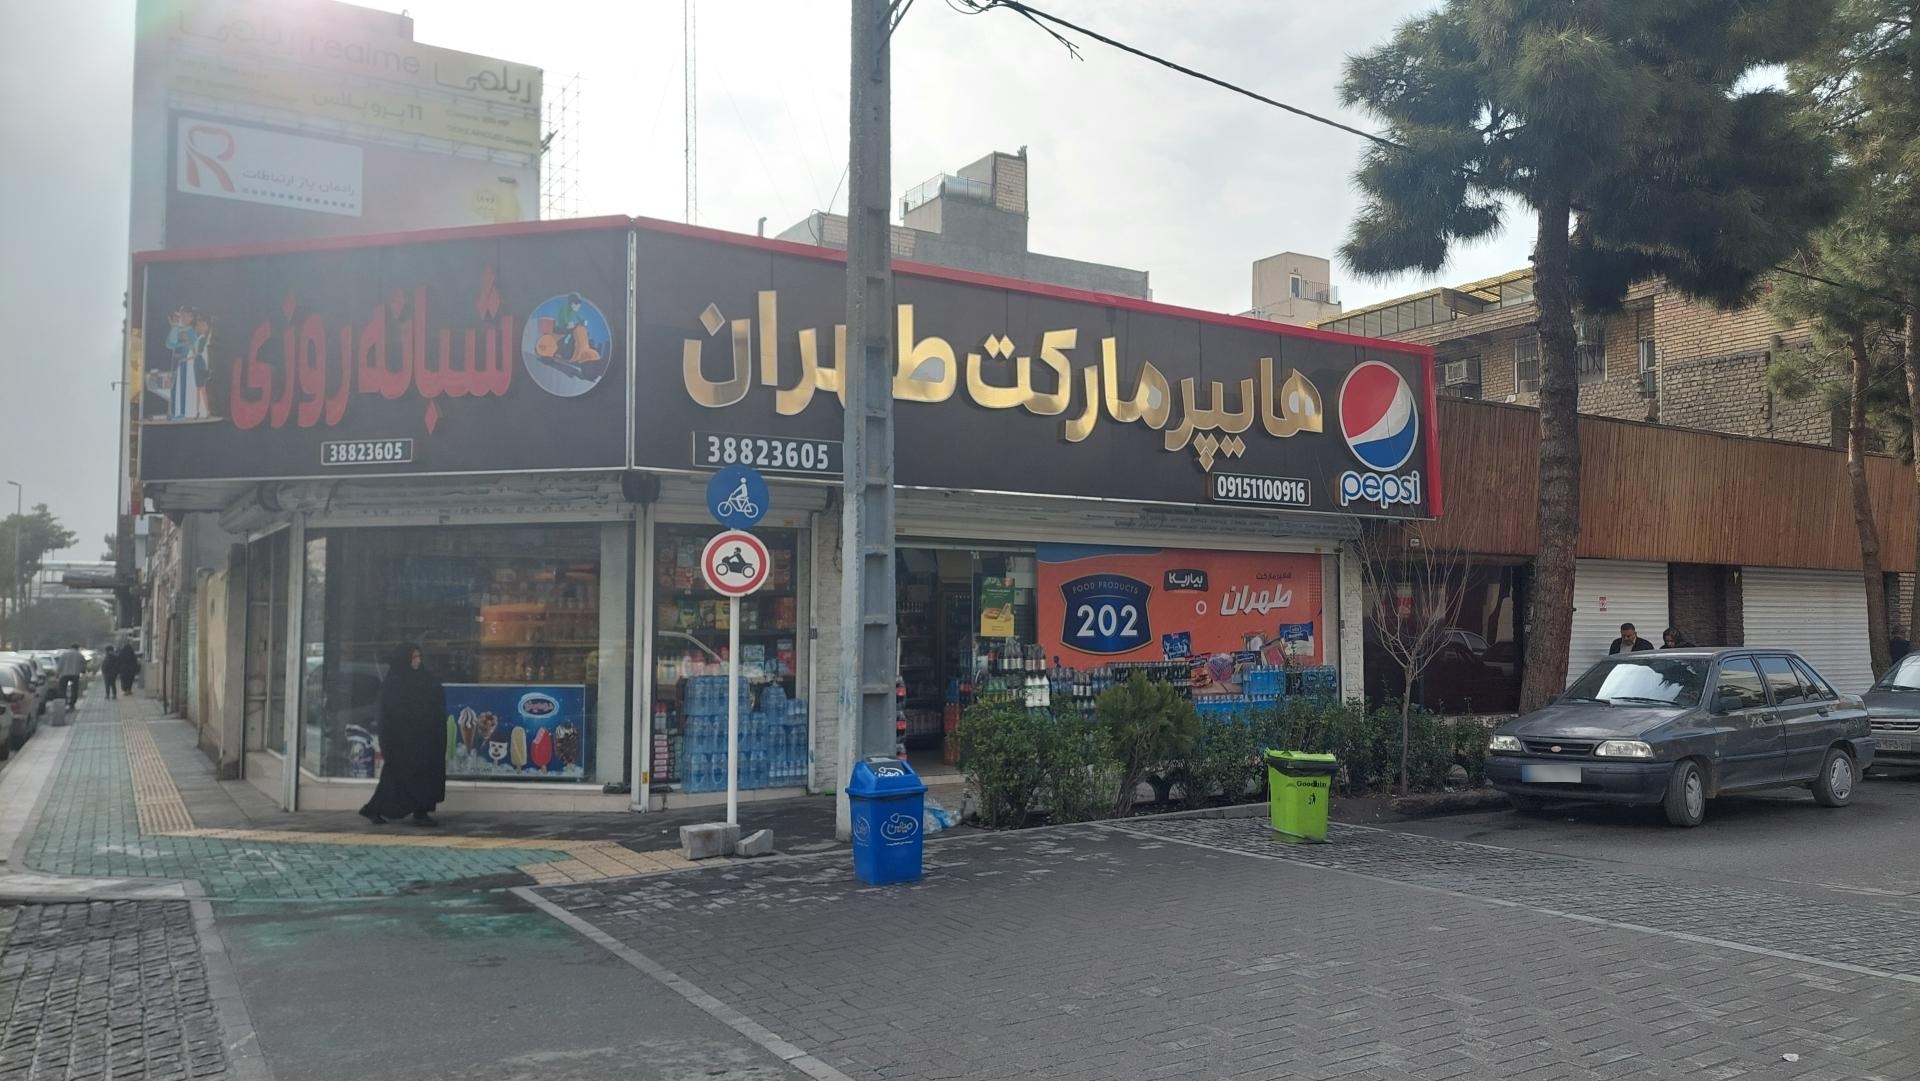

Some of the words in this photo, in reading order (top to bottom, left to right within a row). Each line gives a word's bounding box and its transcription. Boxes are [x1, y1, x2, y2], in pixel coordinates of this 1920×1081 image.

[310, 37, 419, 75] realme
[434, 62, 532, 104] ریلمی
[330, 444, 403, 461] 38823605
[706, 434, 829, 470] 38823605
[1217, 475, 1304, 503] 09151100916
[1340, 469, 1420, 510] pepsi
[1072, 583, 1095, 594] FOOD
[1098, 581, 1139, 595] PRODUCTS
[1220, 582, 1293, 617] طهران
[1076, 604, 1139, 637] 202
